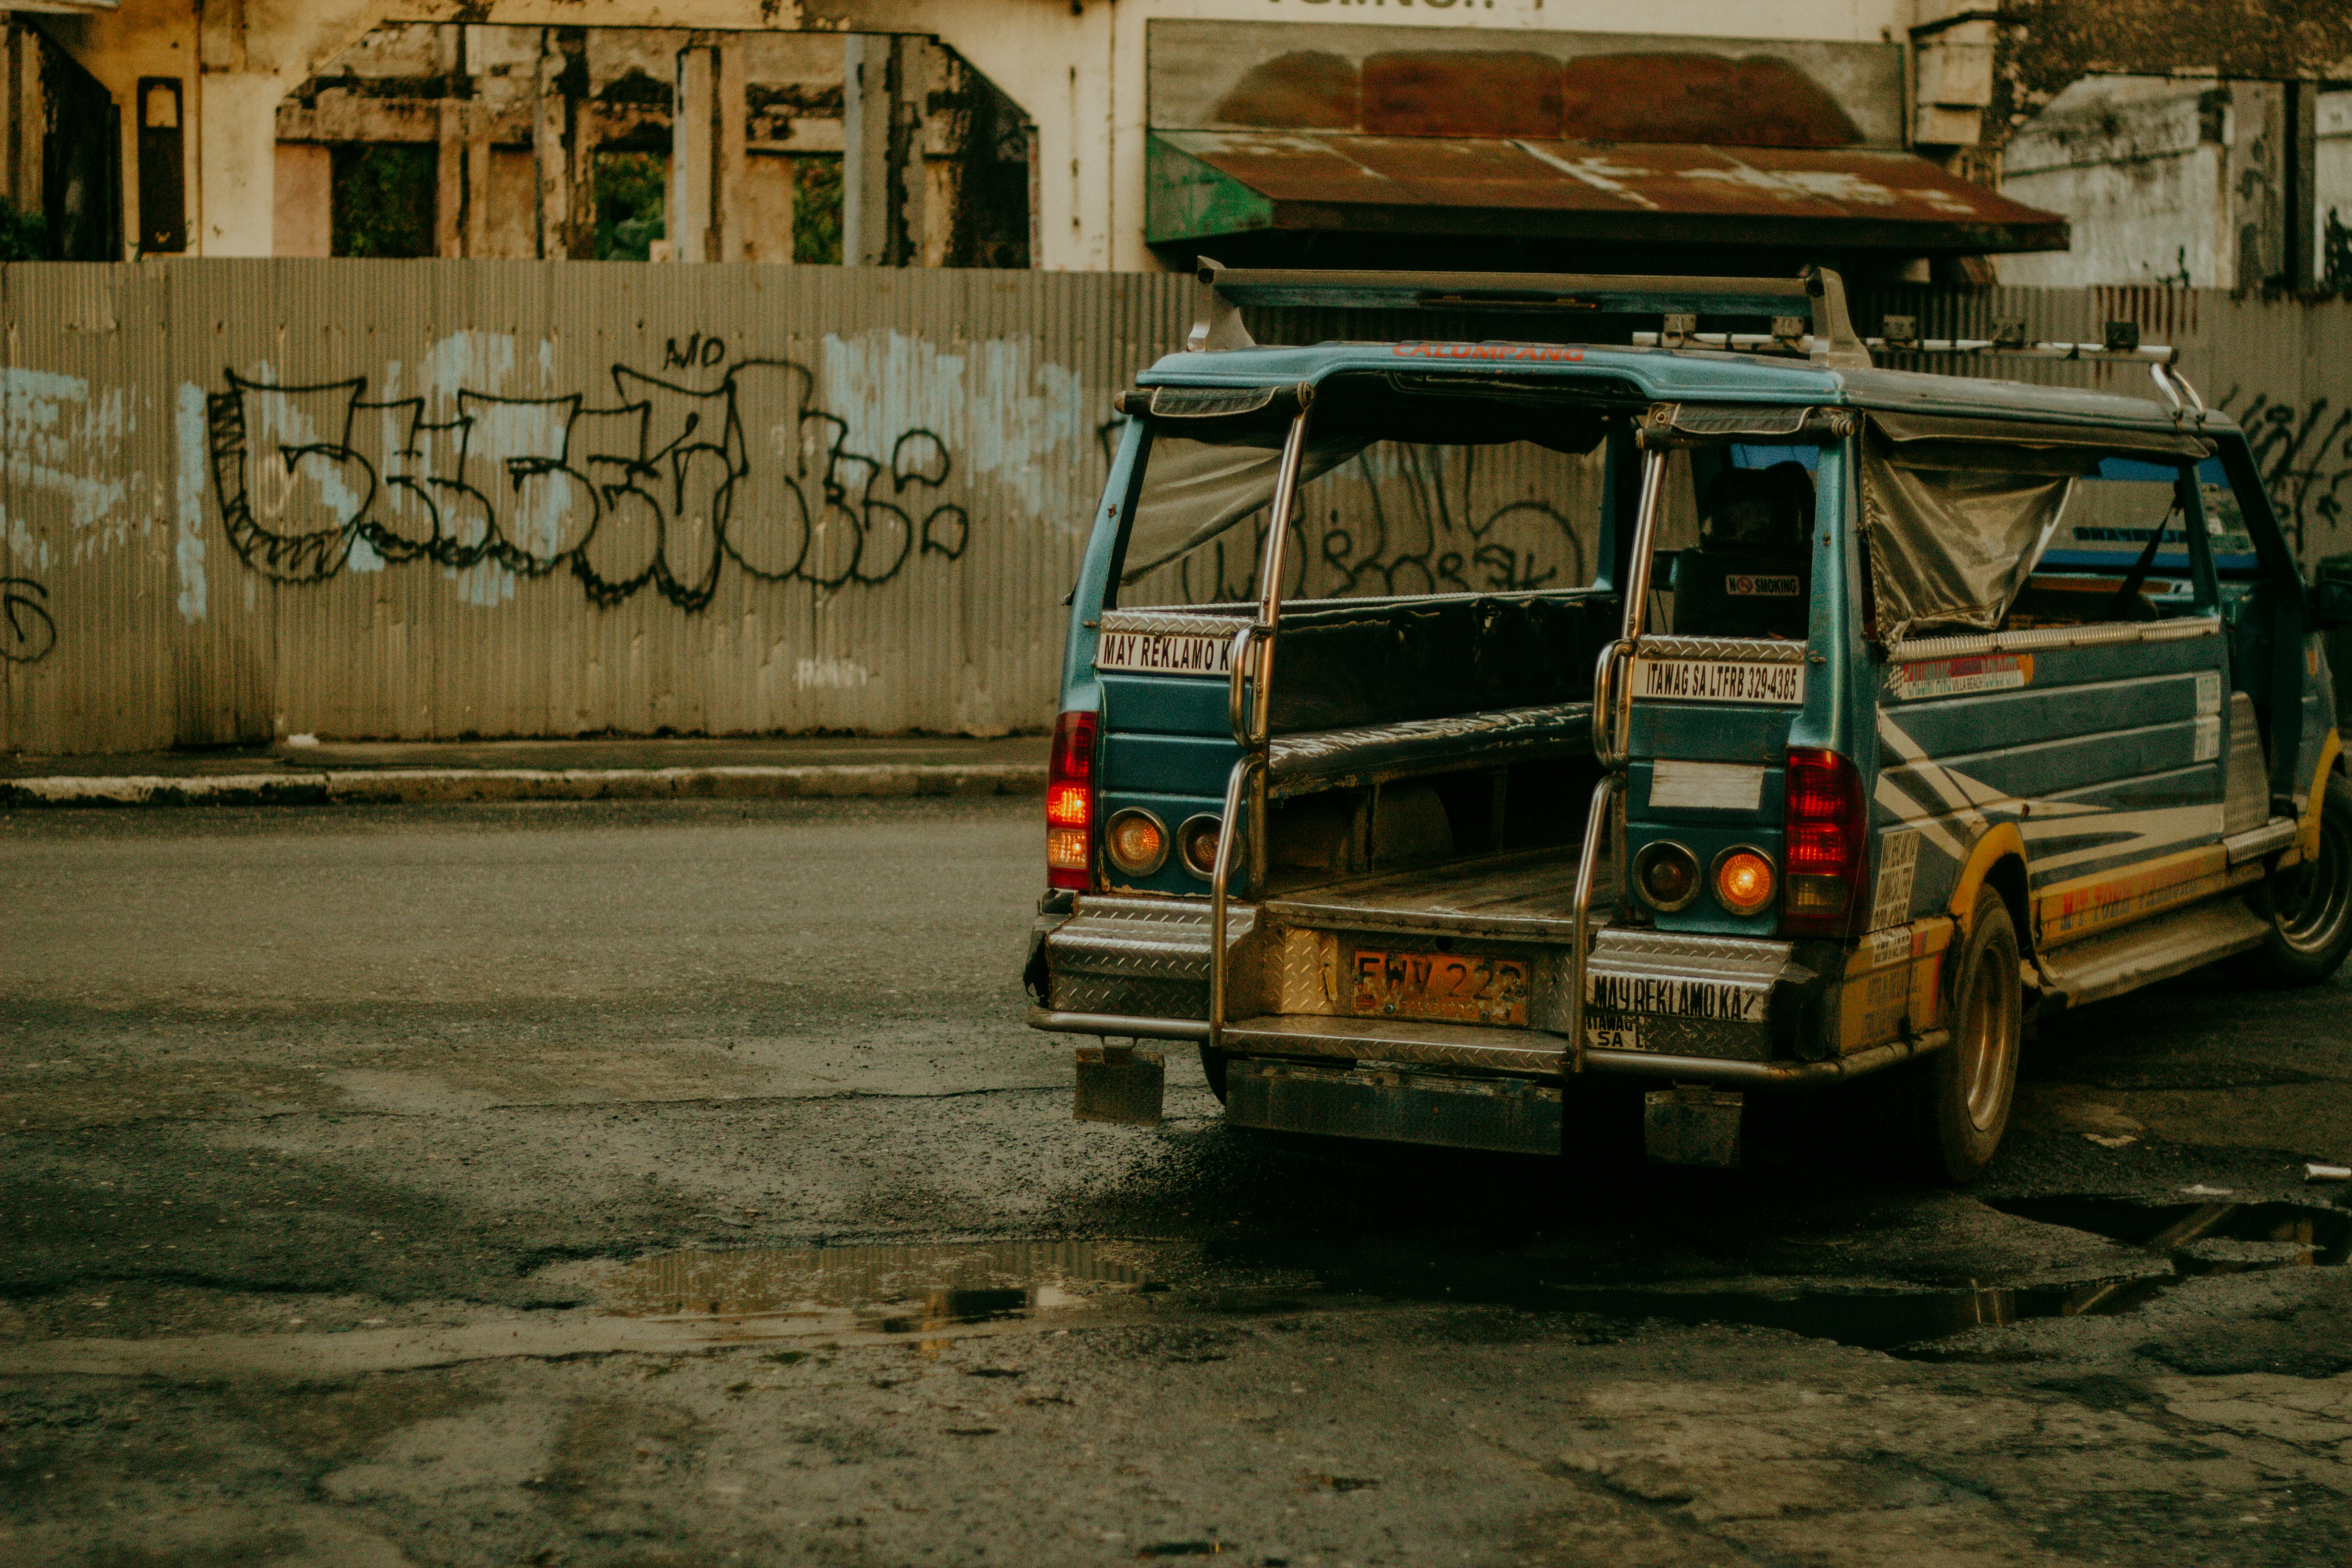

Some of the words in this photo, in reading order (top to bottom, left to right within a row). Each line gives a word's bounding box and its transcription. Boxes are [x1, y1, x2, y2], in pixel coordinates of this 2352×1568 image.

[1392, 345, 1585, 362] CALUMPANG
[1754, 577, 1797, 593] SMOKING
[1103, 634, 1137, 666] MAY
[1140, 636, 1215, 671] REKLAMO
[1646, 662, 1689, 696] ITAWAG
[1692, 664, 1706, 696] SA
[1710, 665, 1744, 697] LTFRB
[1747, 666, 1798, 701] 329-4385
[1952, 678, 1966, 691] VILLA
[1967, 676, 1983, 690] BEACH
[1594, 975, 1631, 1012] MAY
[1634, 978, 1715, 1018] REKLAMO
[1719, 984, 1755, 1021] KA?
[1597, 1031, 1624, 1048] SA
